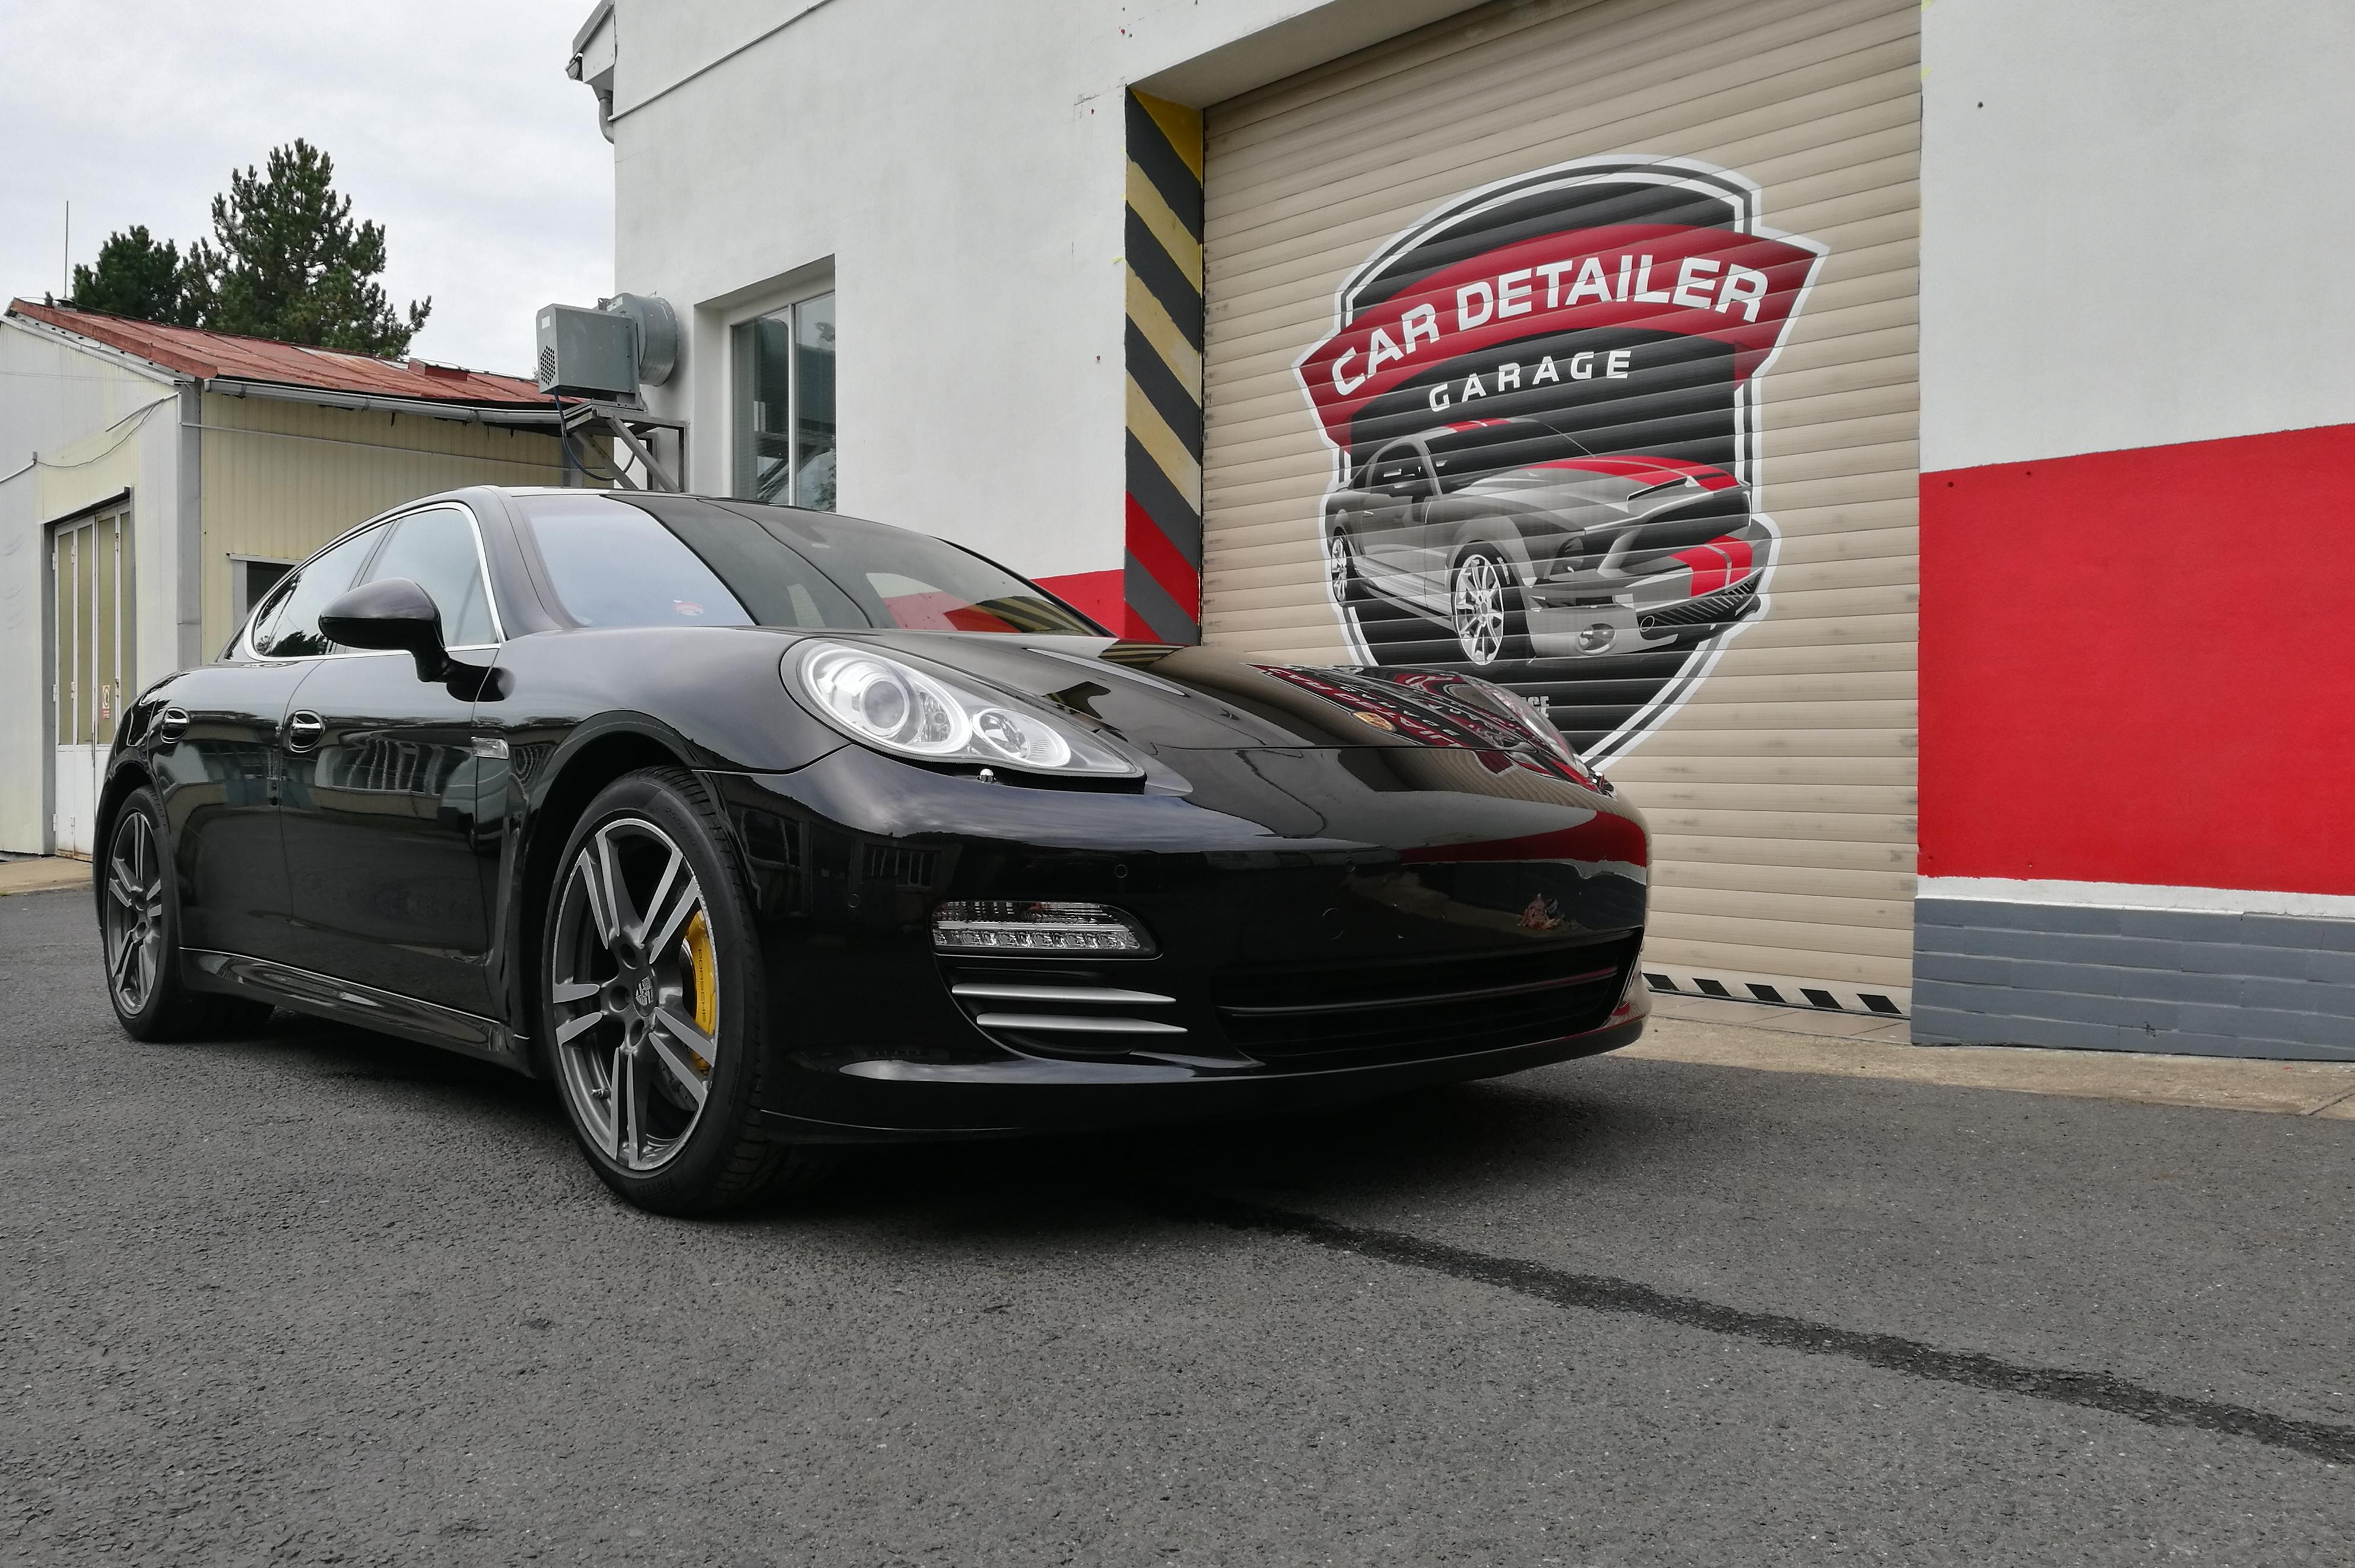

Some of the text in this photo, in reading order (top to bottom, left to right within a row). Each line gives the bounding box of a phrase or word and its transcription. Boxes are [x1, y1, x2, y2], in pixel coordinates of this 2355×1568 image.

[1331, 255, 1769, 396] CAR DETAILER
[1429, 350, 1632, 412] GARAGE
